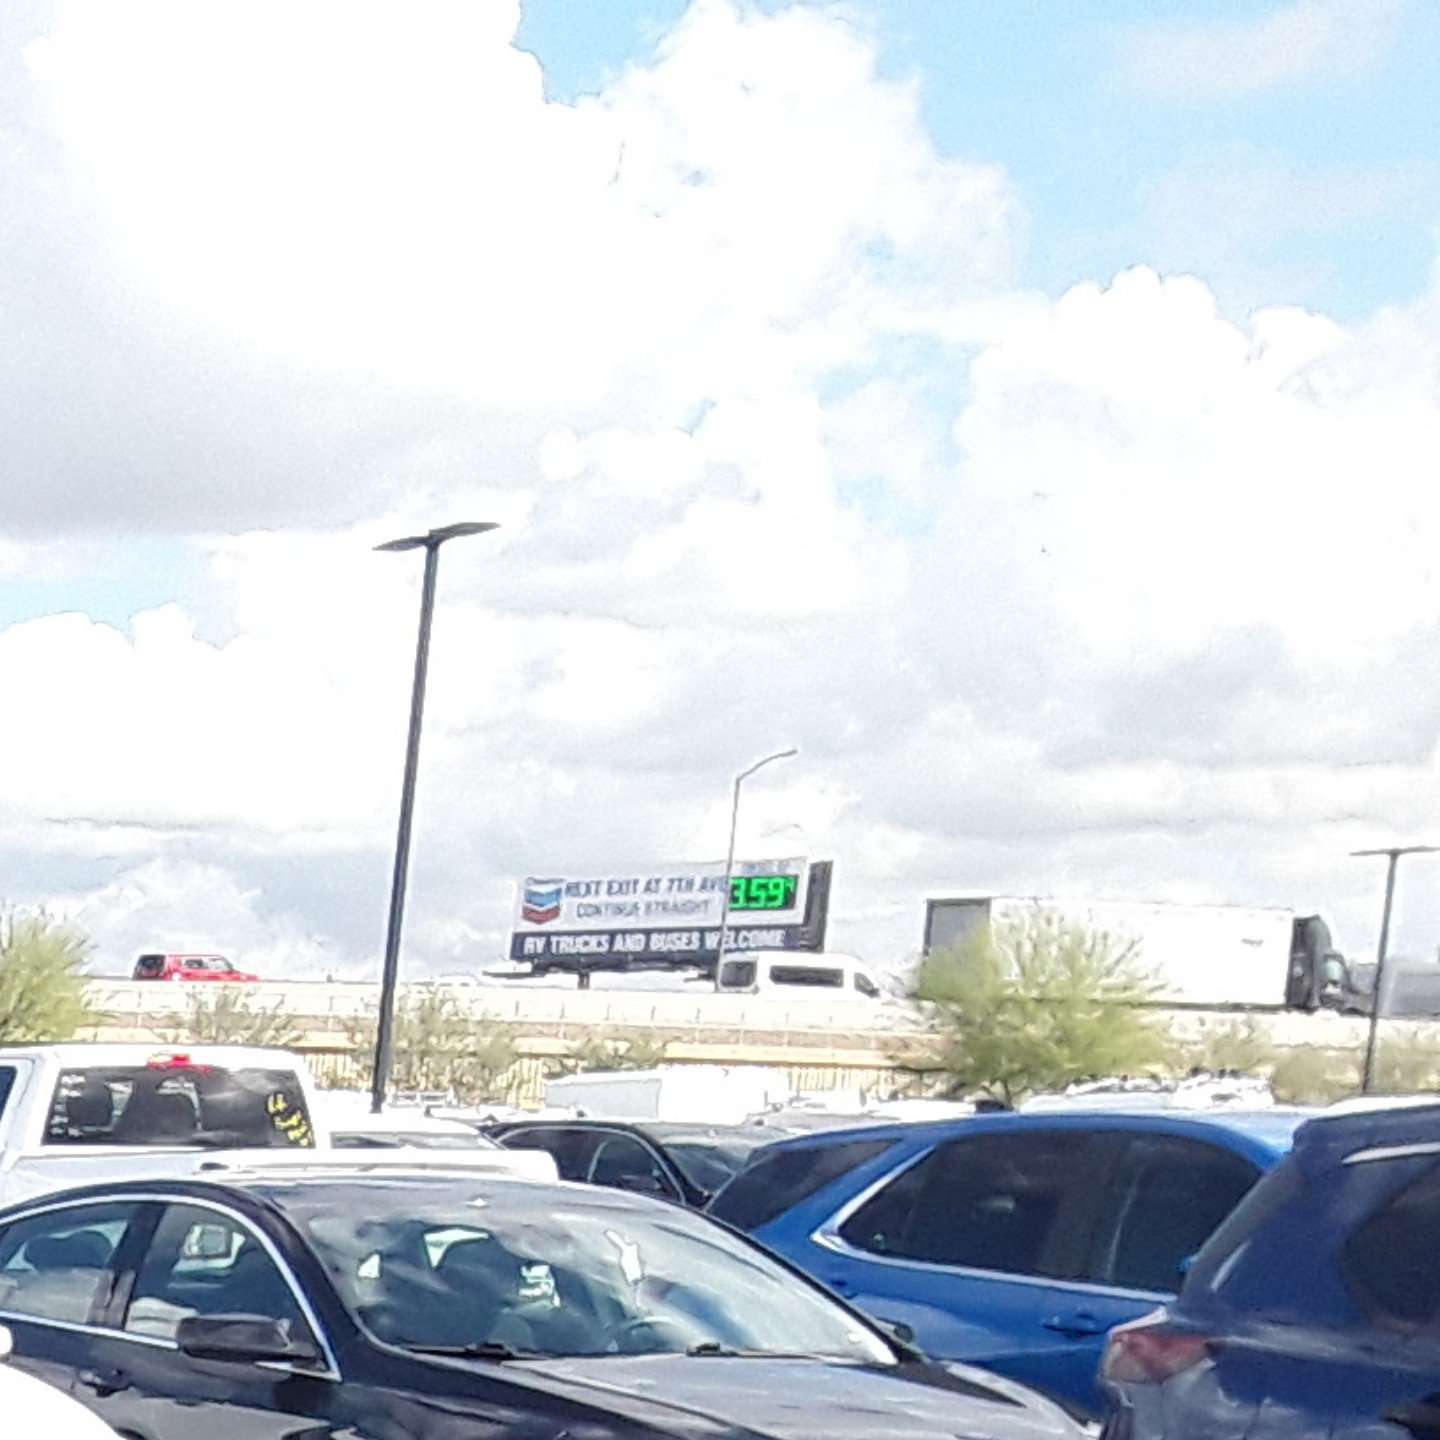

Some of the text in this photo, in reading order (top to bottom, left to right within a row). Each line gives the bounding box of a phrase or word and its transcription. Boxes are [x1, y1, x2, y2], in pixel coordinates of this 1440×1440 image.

[607, 878, 639, 895] EXIT
[644, 878, 661, 893] AT
[523, 929, 786, 954] RV TRUCKS AND BUSES WELCOME
